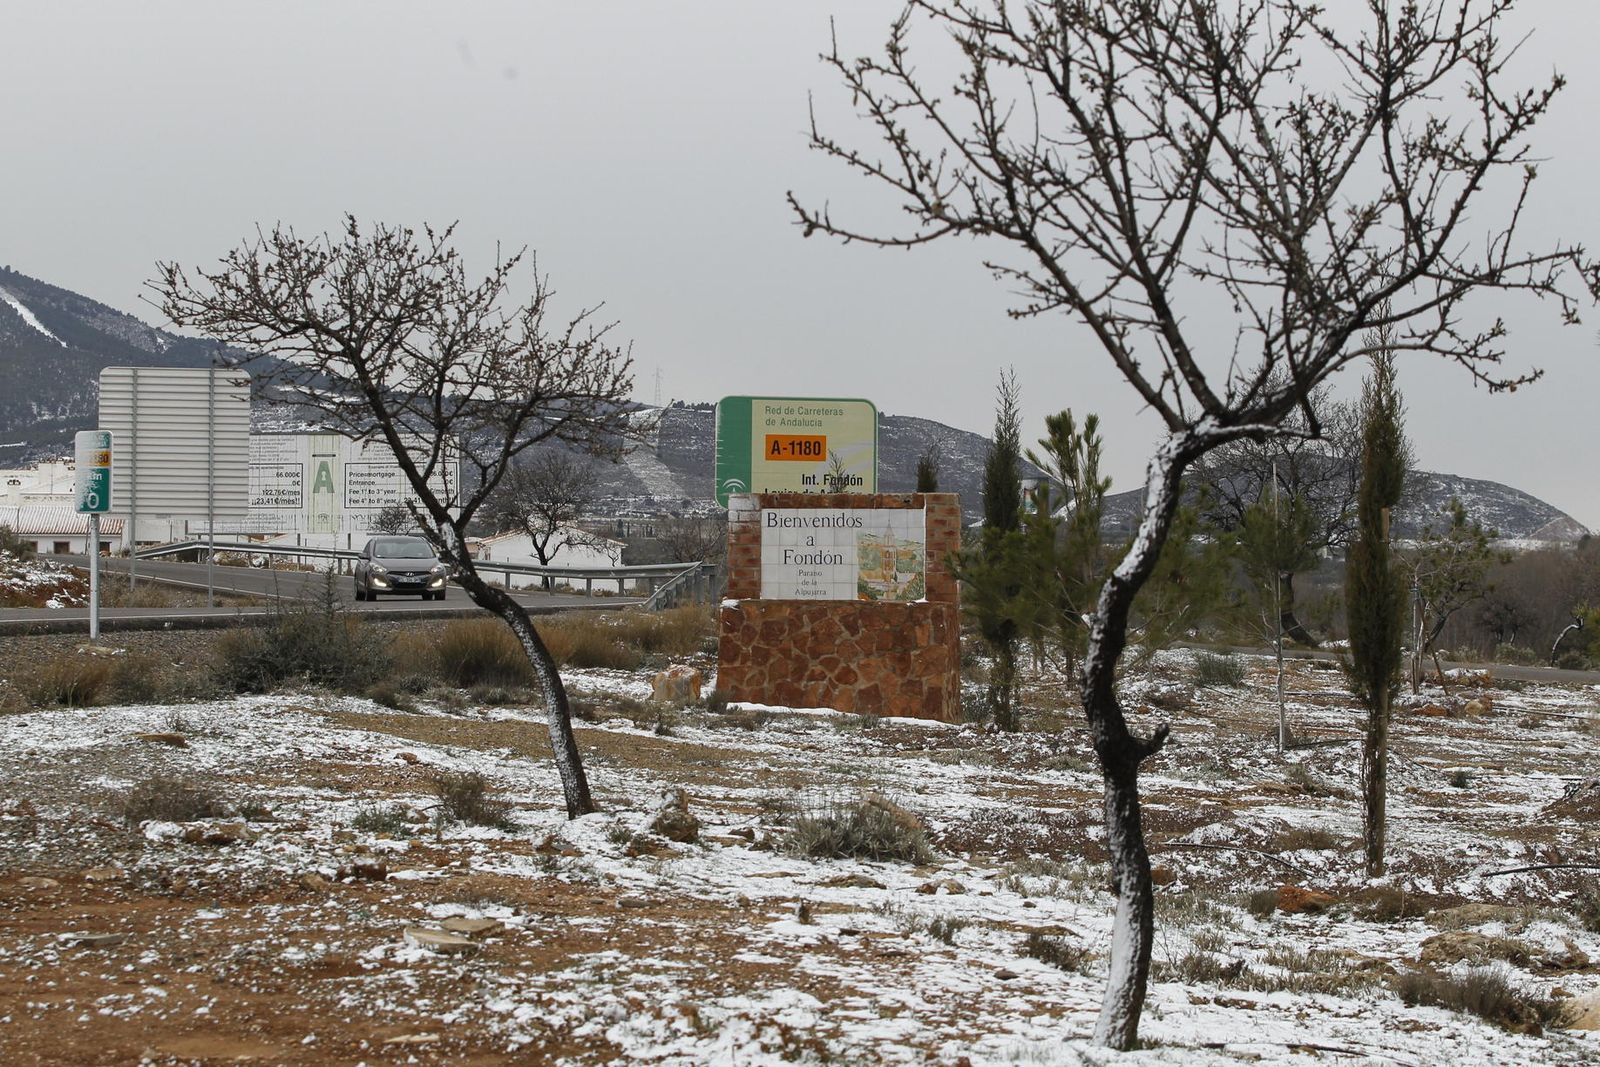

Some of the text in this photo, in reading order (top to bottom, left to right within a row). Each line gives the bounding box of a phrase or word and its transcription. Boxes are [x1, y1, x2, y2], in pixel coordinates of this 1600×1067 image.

[765, 406, 844, 416] Red de Carreteras
[765, 418, 776, 426] de
[771, 440, 821, 456] A-1180
[802, 474, 819, 486] Int.
[767, 511, 863, 528] Bienvenidos
[806, 535, 815, 547] a
